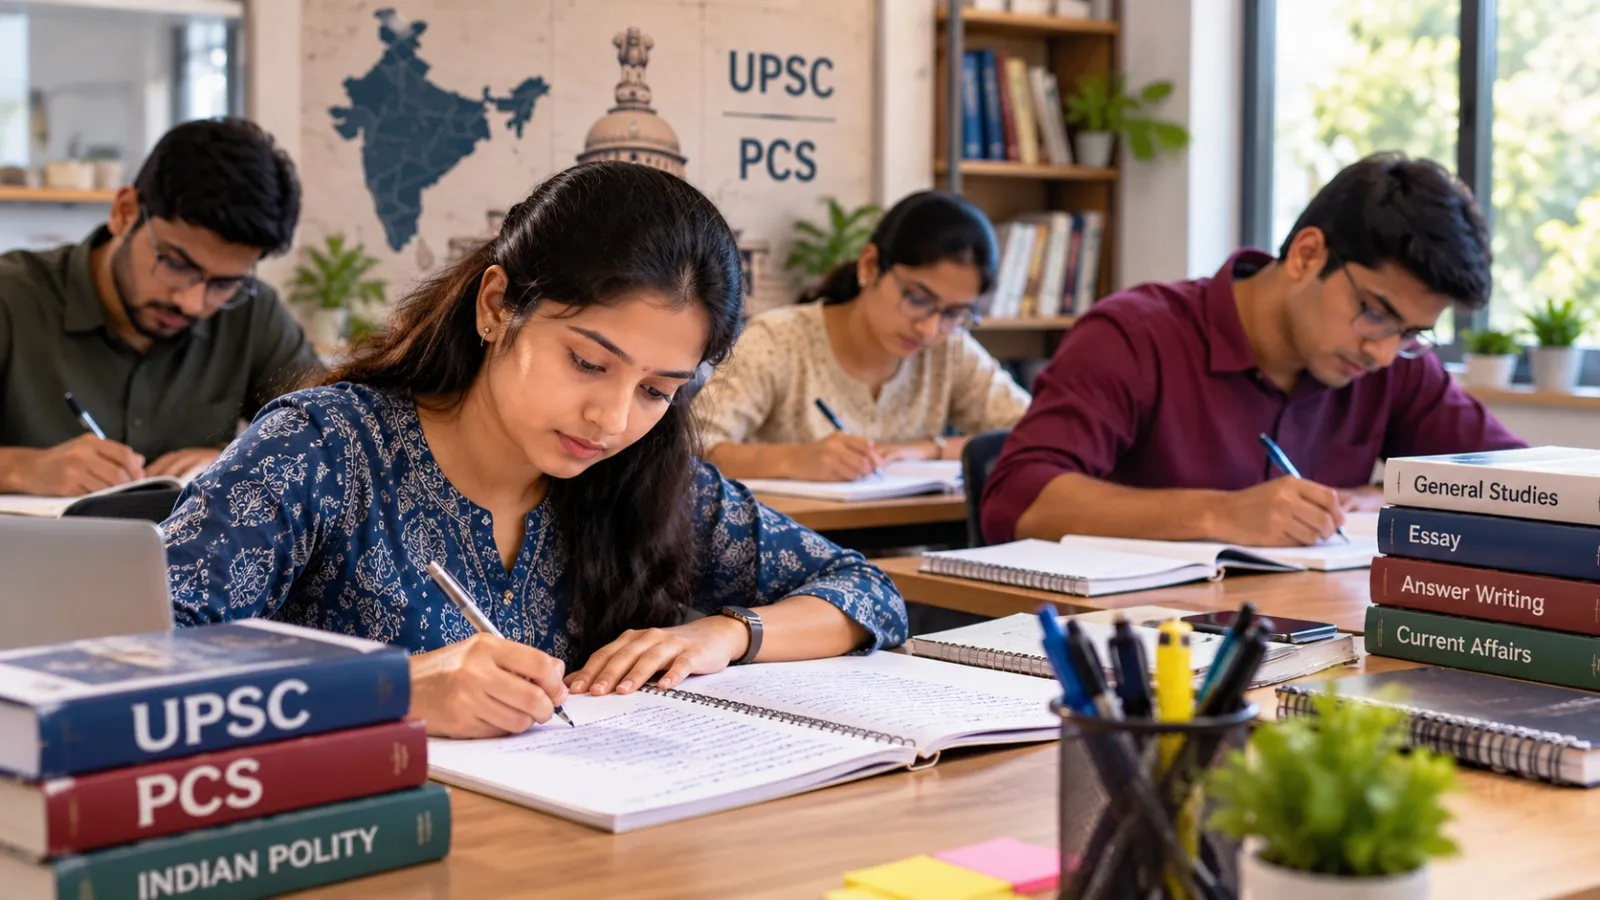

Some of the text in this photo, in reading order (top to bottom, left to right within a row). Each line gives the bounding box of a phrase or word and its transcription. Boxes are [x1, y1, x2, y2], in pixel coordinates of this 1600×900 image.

[729, 50, 835, 99] UPSC
[740, 138, 817, 183] PCS
[1414, 475, 1559, 506] General Studies
[1409, 524, 1462, 552] Essay
[1401, 575, 1545, 616] Answer Writing
[1396, 625, 1532, 663] Current Affairs
[131, 679, 310, 752] UPSC
[136, 758, 263, 828] PCS
[137, 850, 258, 900] INDIAN
[269, 825, 379, 874] POLITY
